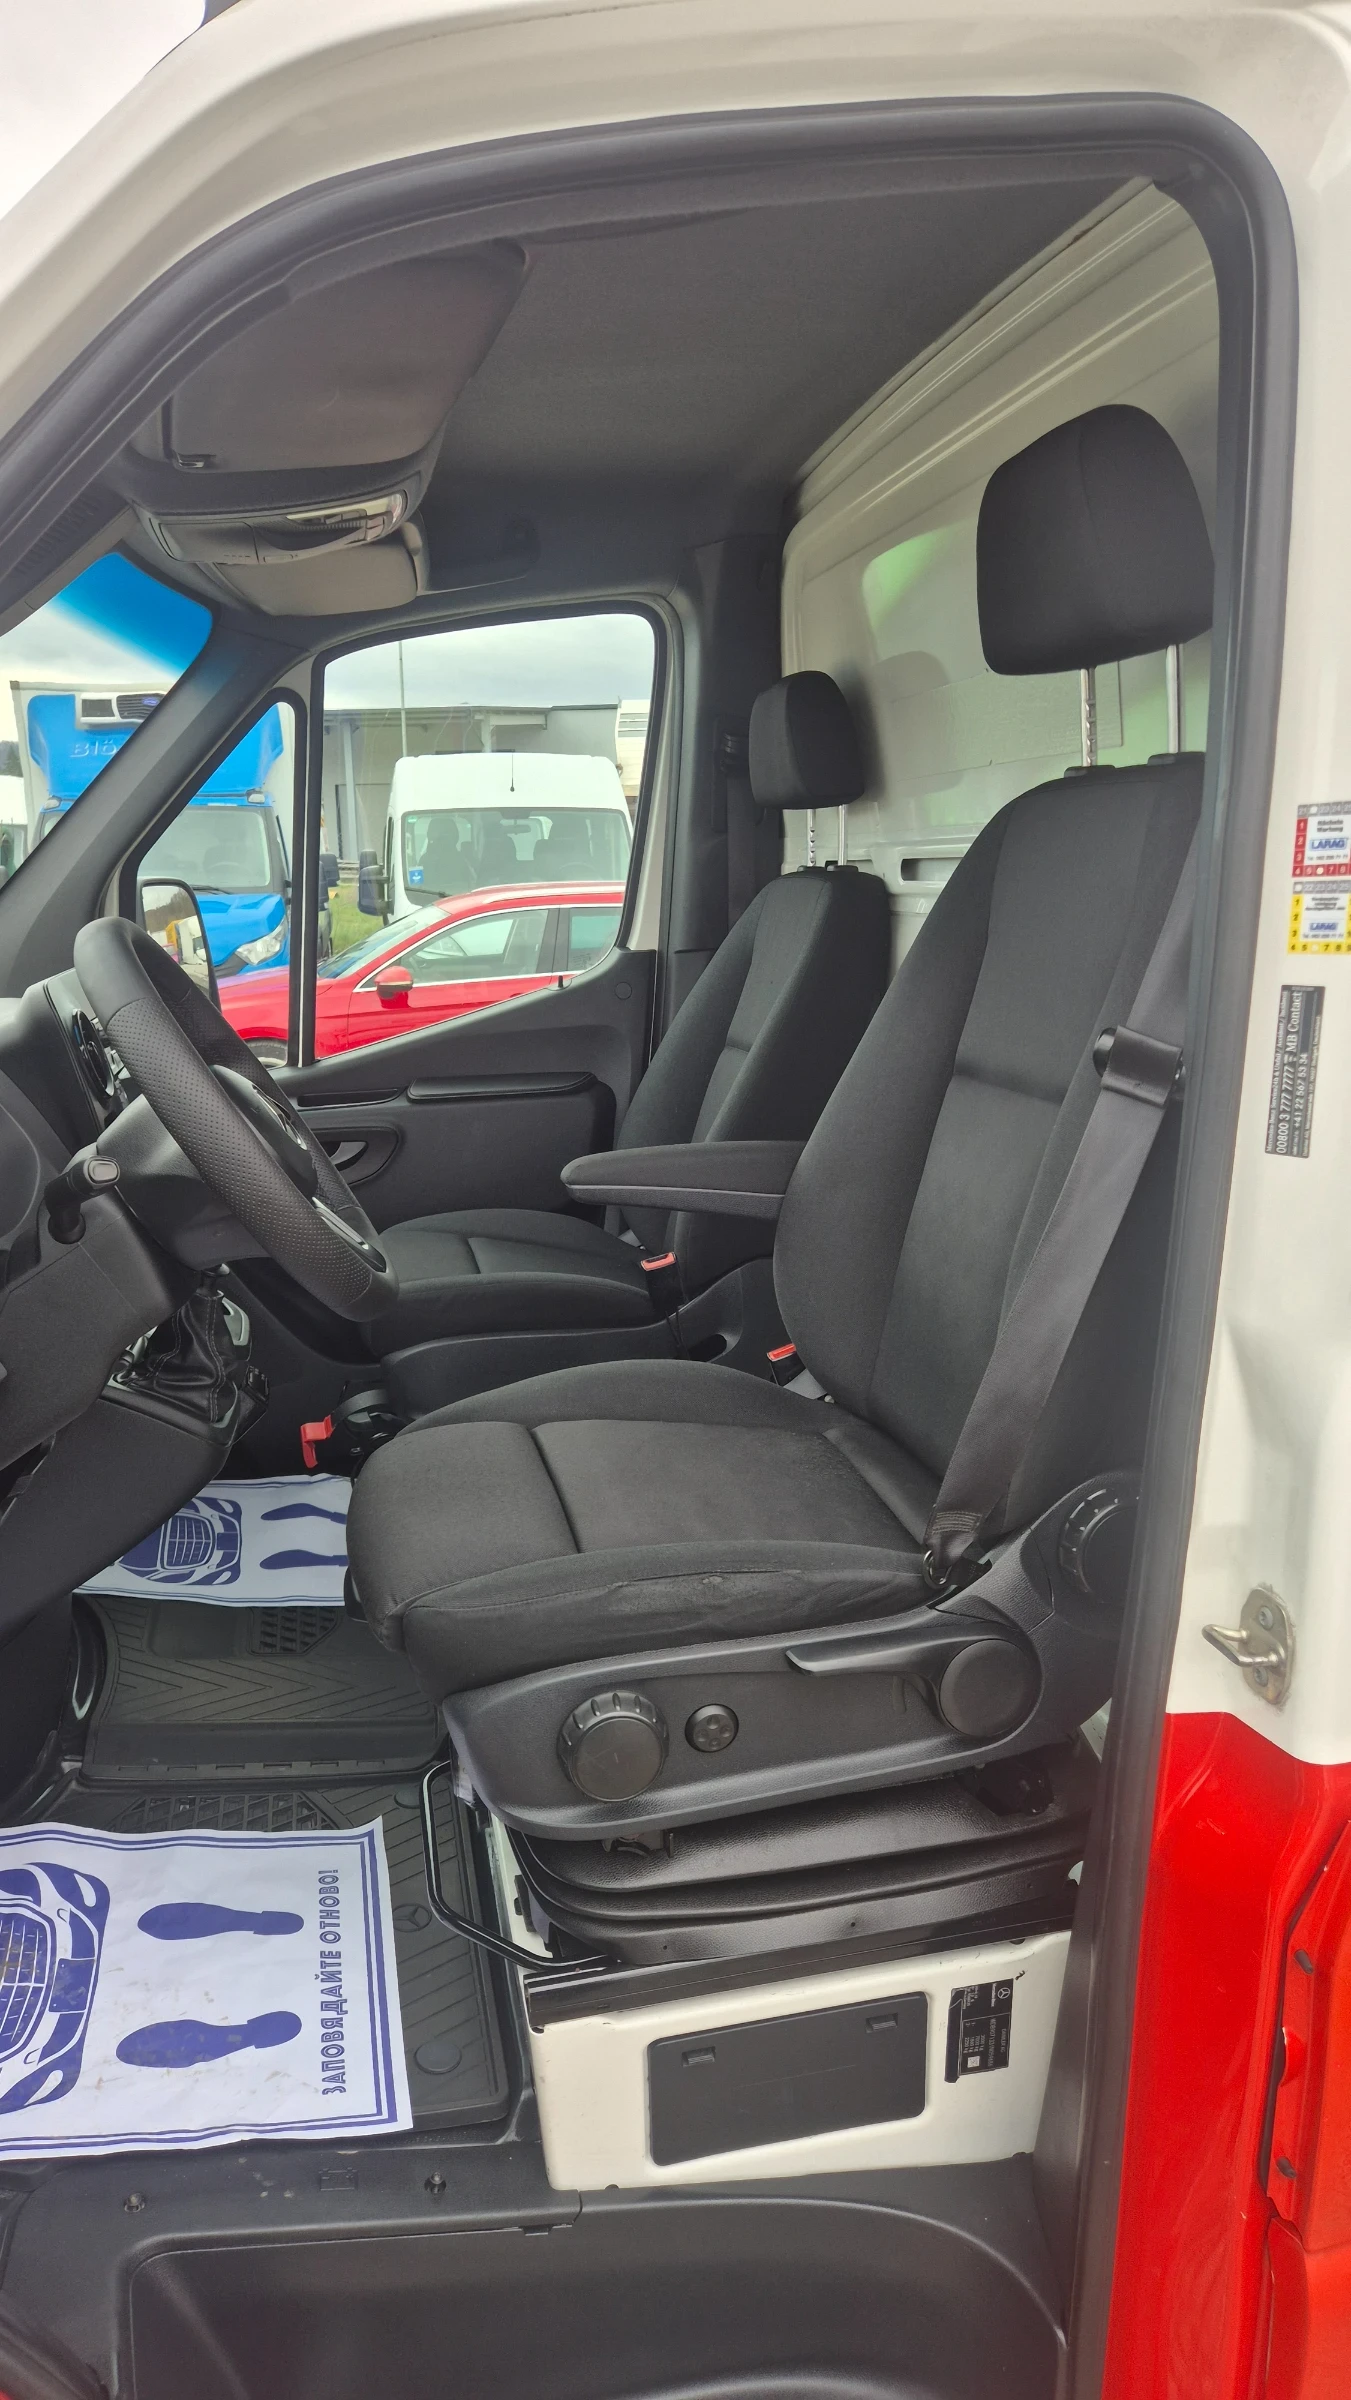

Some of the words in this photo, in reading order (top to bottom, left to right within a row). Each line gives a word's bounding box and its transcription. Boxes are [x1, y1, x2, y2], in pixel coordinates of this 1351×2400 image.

[1287, 991, 1302, 1032] Contact
[1285, 1035, 1298, 1053] MB
[1299, 1053, 1308, 1065] 34
[1282, 1065, 1294, 1091] 7777
[1298, 1066, 1307, 1078] 53
[1296, 1079, 1305, 1096] 567
[1280, 1092, 1292, 1112] 777
[1295, 1099, 1304, 1109] 22
[1279, 1113, 1290, 1121] 3
[1294, 1112, 1302, 1128] +41
[1276, 1122, 1289, 1154] 00800
[318, 1869, 341, 1944] ОТНОВО!
[314, 1950, 348, 2096] ЗАПОВЯДАЙТЕ
